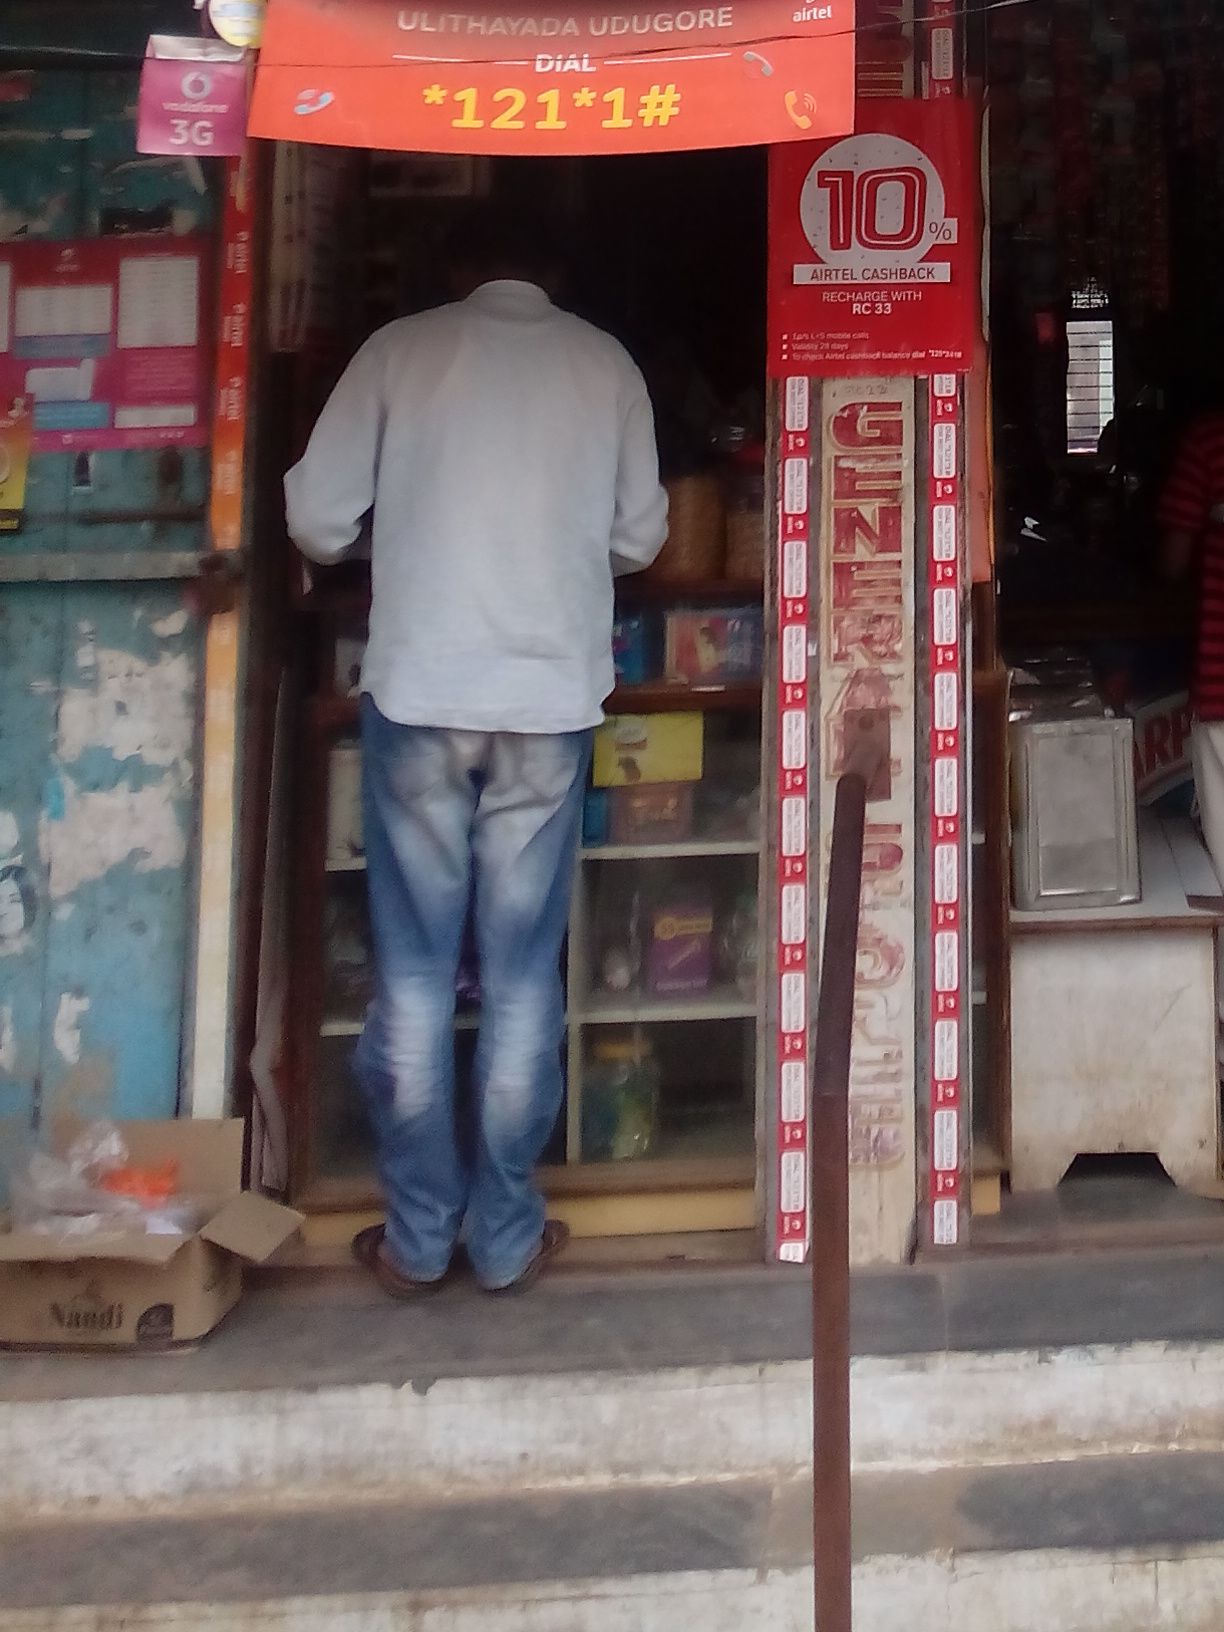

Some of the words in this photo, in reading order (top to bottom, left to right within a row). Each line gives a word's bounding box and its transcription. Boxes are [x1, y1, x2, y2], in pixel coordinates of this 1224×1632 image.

[397, 8, 582, 38] ULITHAYADA
[588, 6, 734, 37] UDUGORE
[793, 4, 833, 24] airtel
[535, 53, 597, 75] DIAL
[169, 119, 215, 146] 3G
[810, 267, 857, 282] AIRTEL
[861, 266, 936, 281] CASHBACK
[822, 291, 888, 304] RECHARGE
[890, 290, 922, 303] WITH
[852, 302, 871, 316] RC
[874, 302, 893, 315] 33
